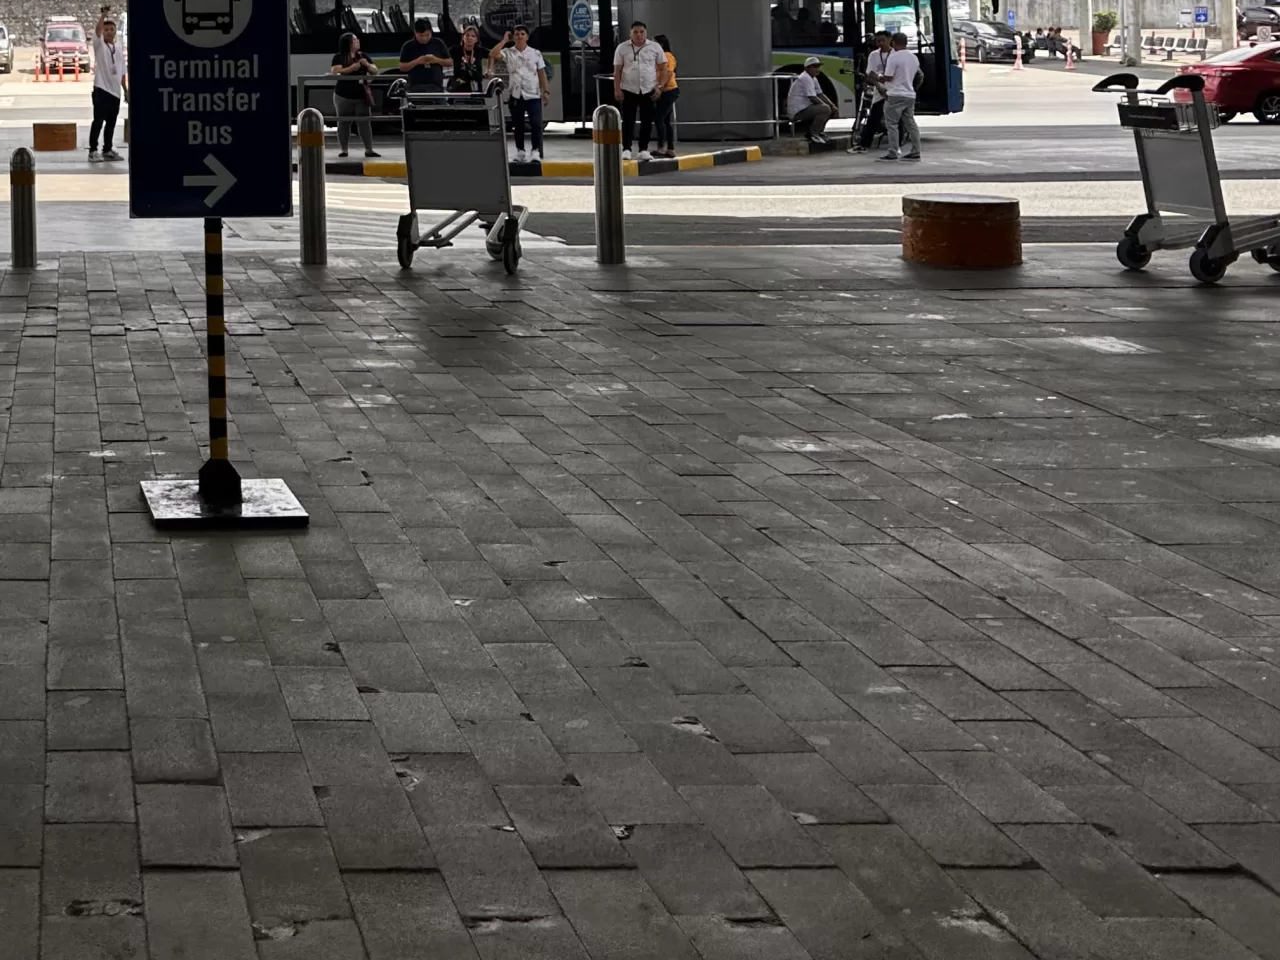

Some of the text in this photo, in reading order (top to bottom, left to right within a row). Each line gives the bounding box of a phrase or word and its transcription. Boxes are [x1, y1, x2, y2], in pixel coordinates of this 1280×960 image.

[149, 54, 259, 79] Terminal
[158, 87, 261, 112] Transfer
[187, 120, 233, 145] Bus
